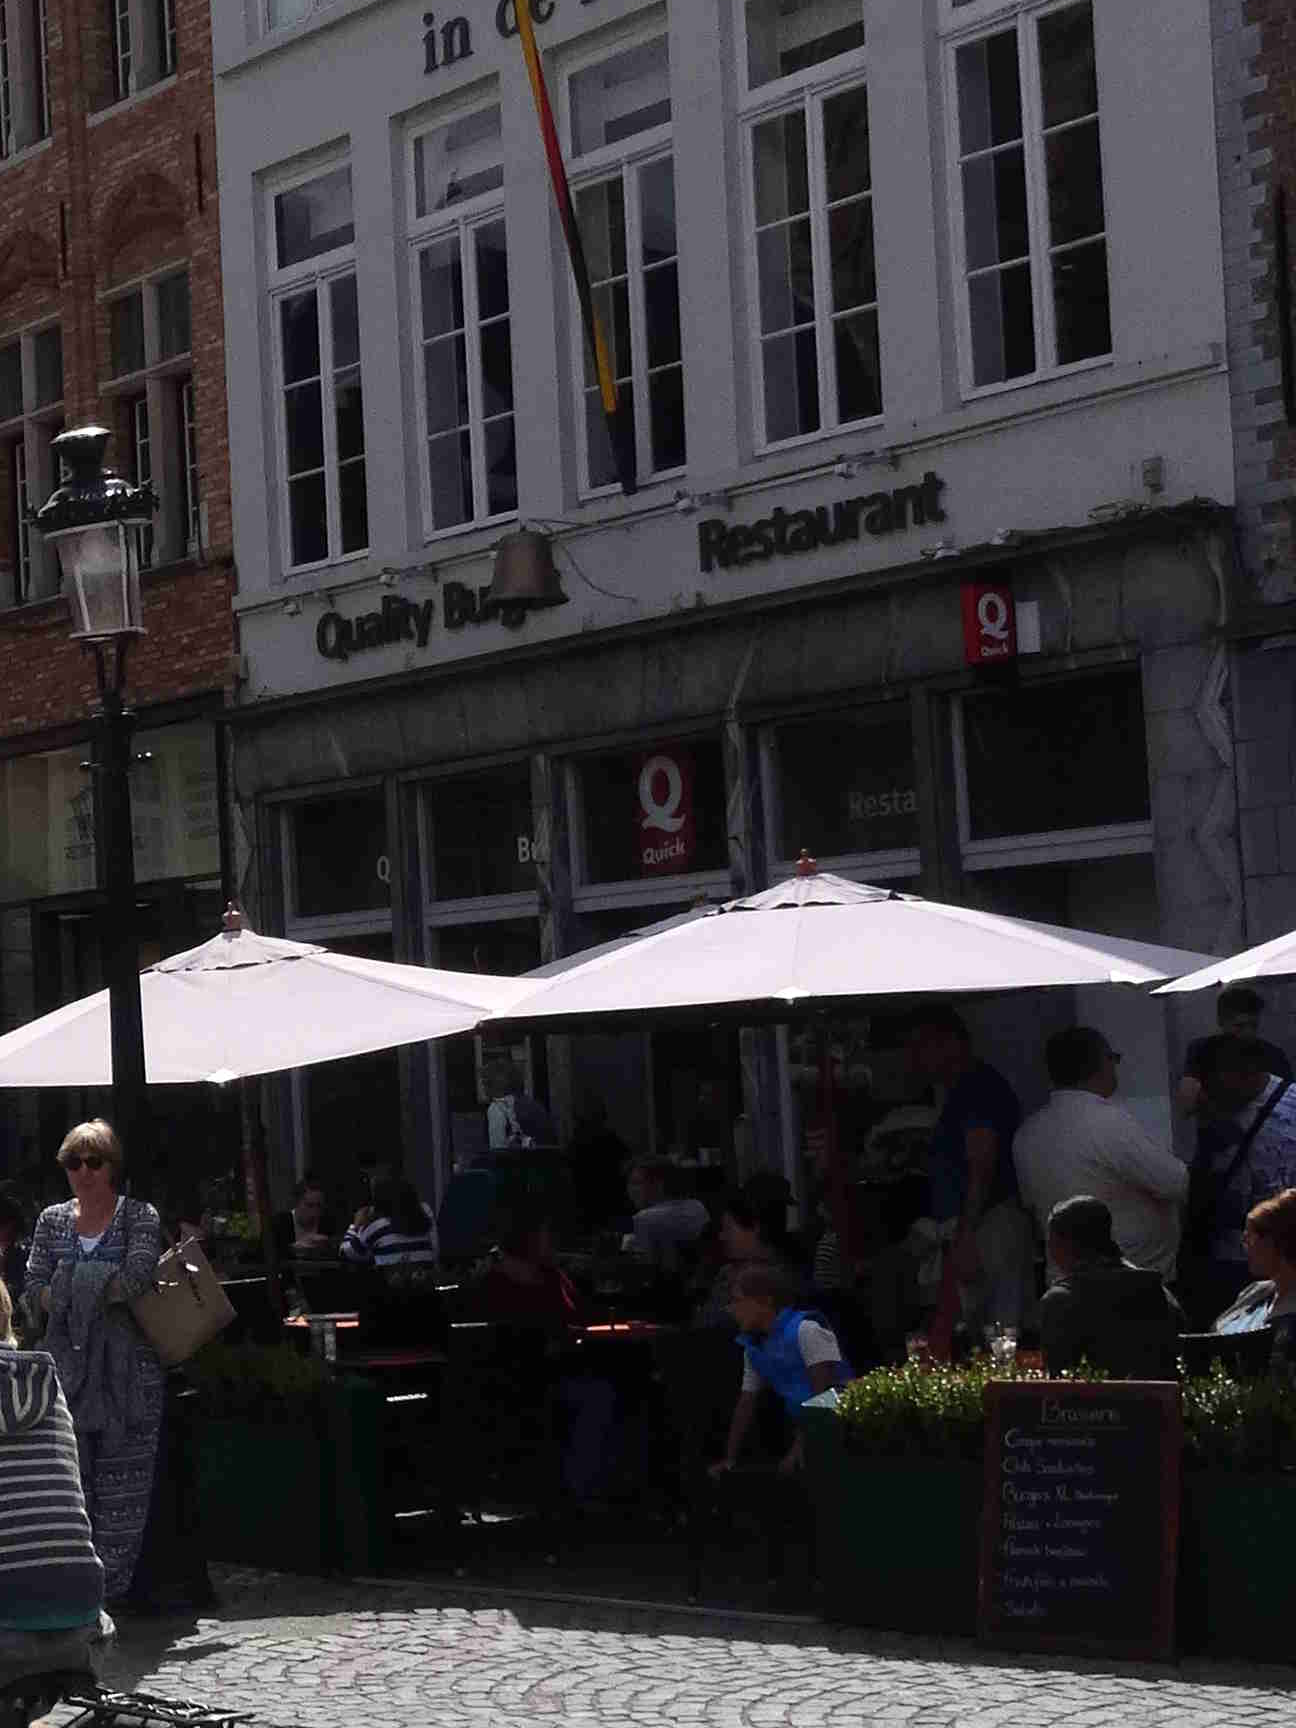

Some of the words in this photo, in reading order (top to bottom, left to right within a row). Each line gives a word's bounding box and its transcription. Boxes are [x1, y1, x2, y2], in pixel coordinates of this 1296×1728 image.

[423, 12, 474, 73] in
[315, 595, 434, 665] Quality
[698, 471, 948, 573] Restaurant
[642, 835, 687, 864] Quick
